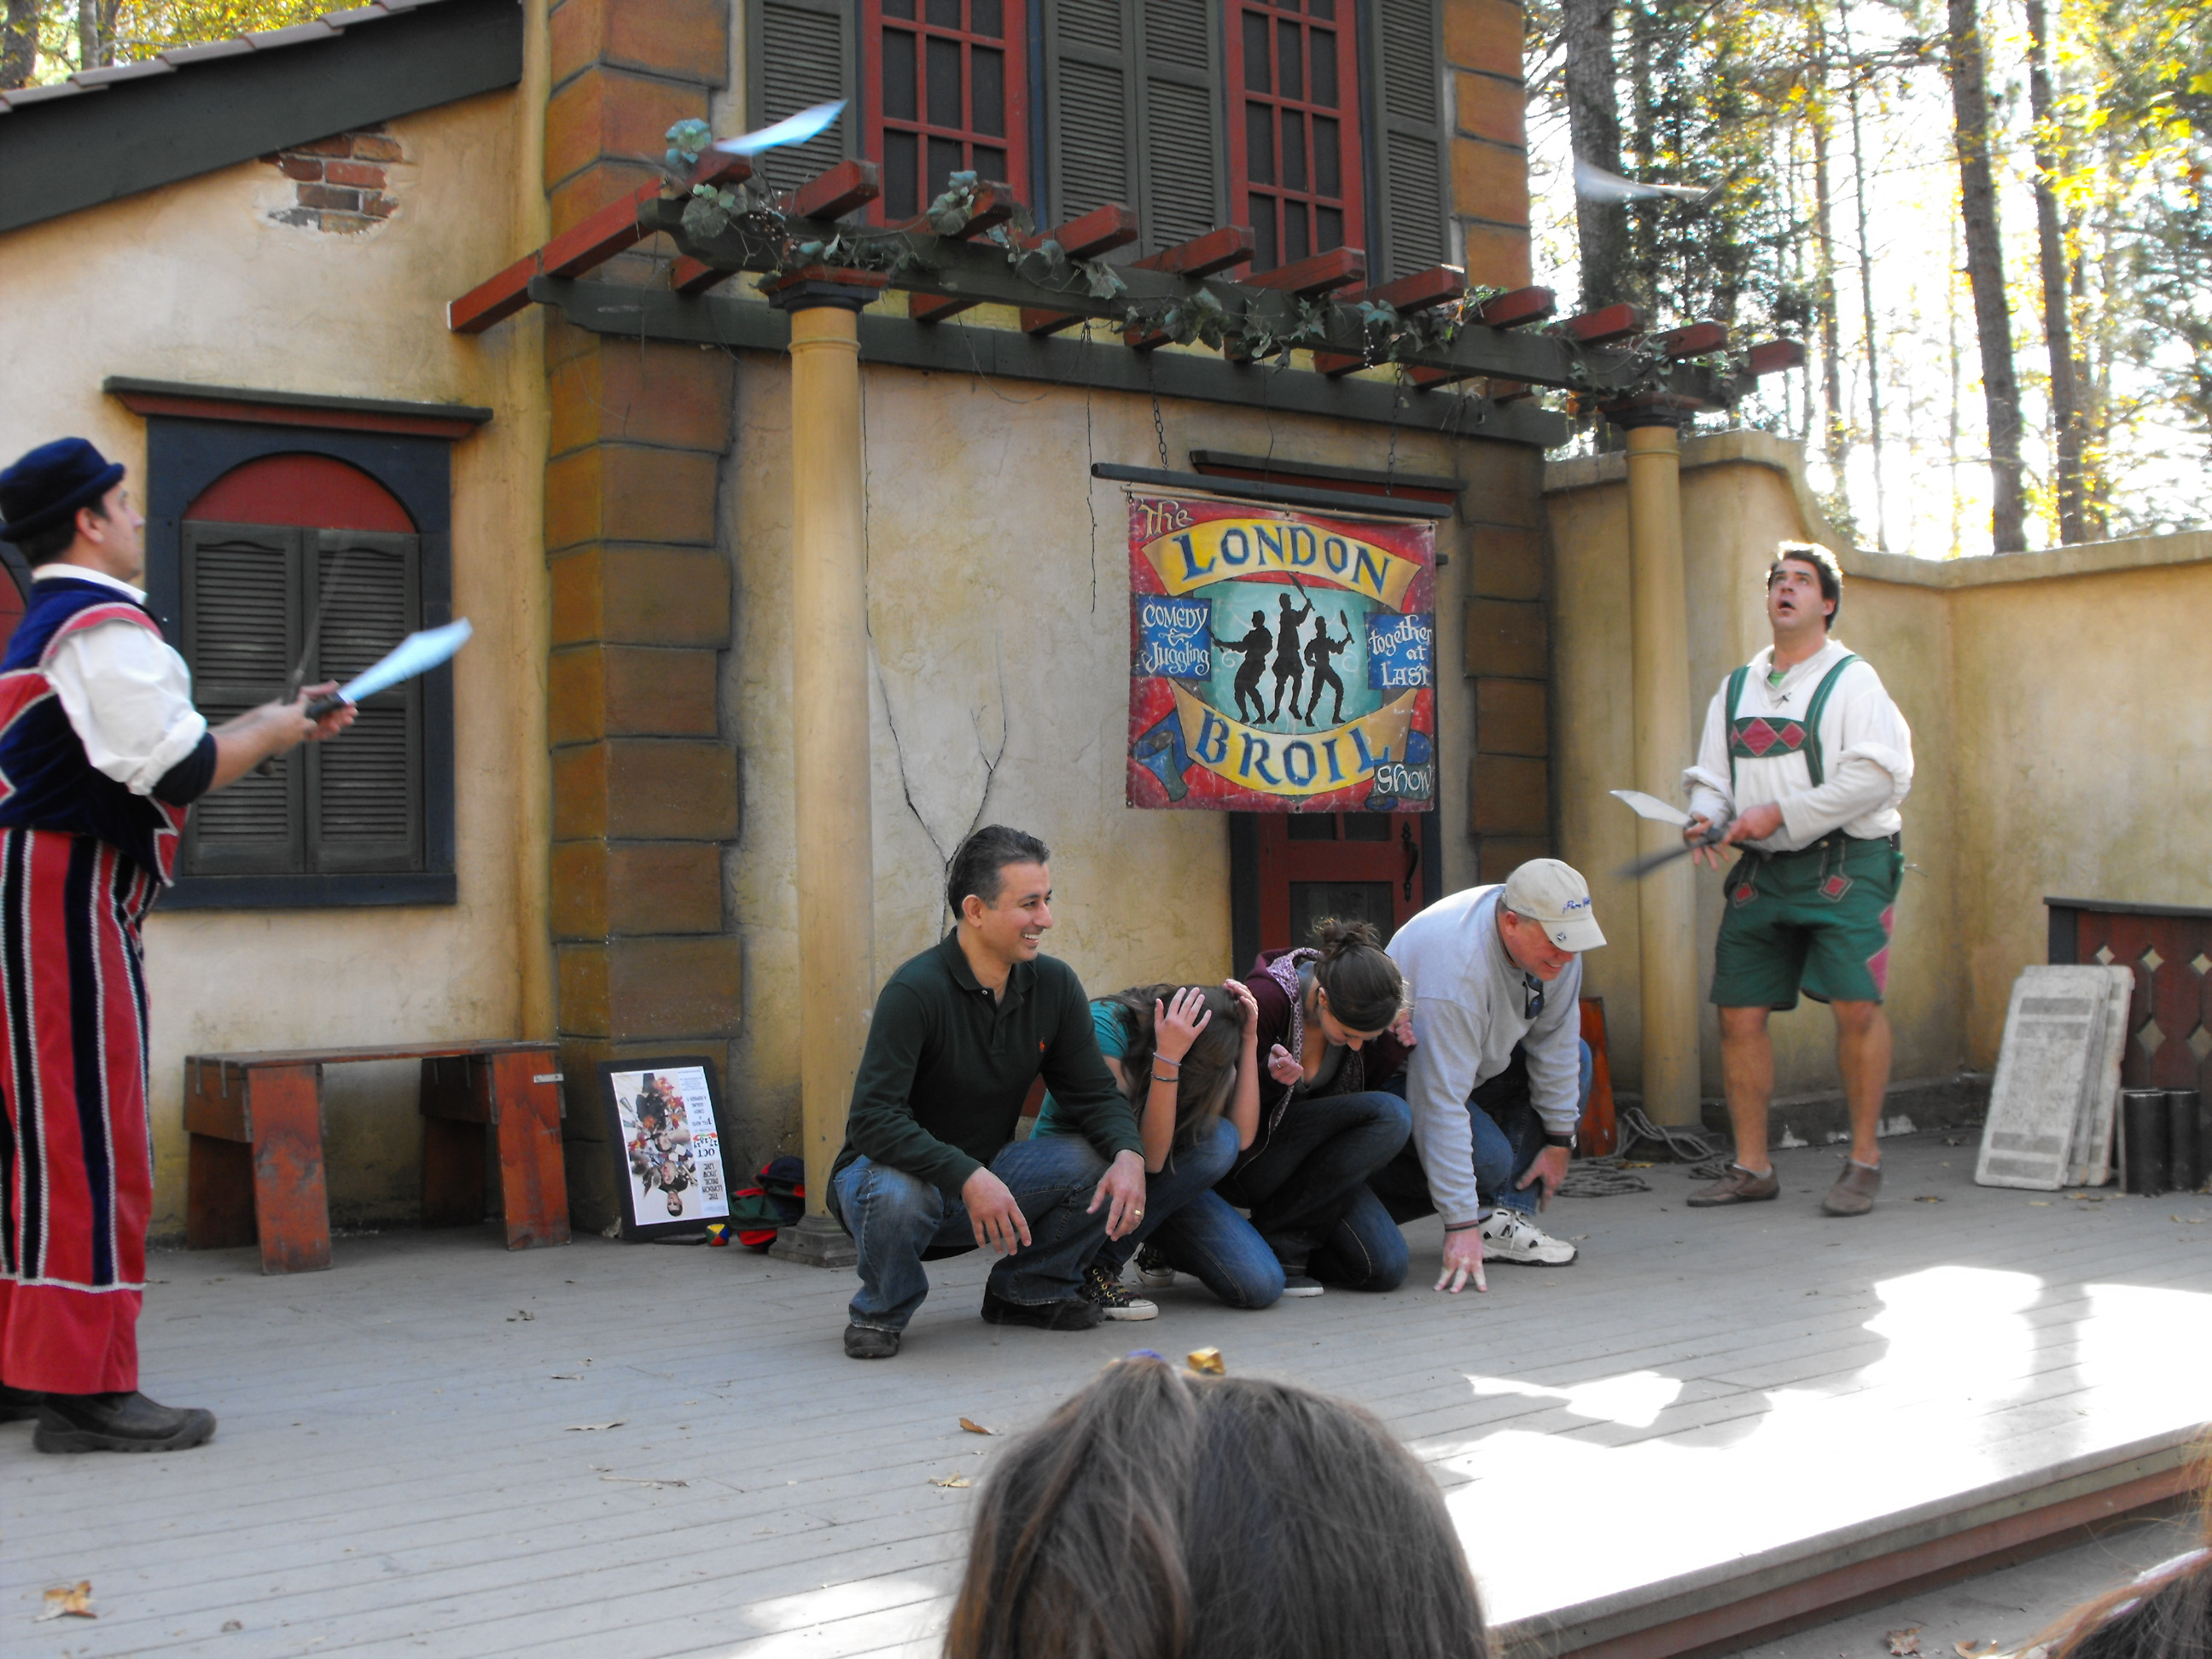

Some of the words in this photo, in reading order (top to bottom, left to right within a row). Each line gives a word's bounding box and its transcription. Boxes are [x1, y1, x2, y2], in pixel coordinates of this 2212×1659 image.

[1133, 498, 1195, 541] The
[1172, 525, 1391, 596] LONDON
[1158, 627, 1194, 647] &
[1368, 614, 1433, 657] together
[1143, 641, 1211, 676] Juggling
[1406, 644, 1427, 661] at
[1380, 661, 1431, 686] LAST
[1195, 707, 1393, 788] BROIL
[1377, 763, 1432, 795] Show
[698, 1148, 715, 1158] OCT
[702, 1185, 723, 1193] LONDON
